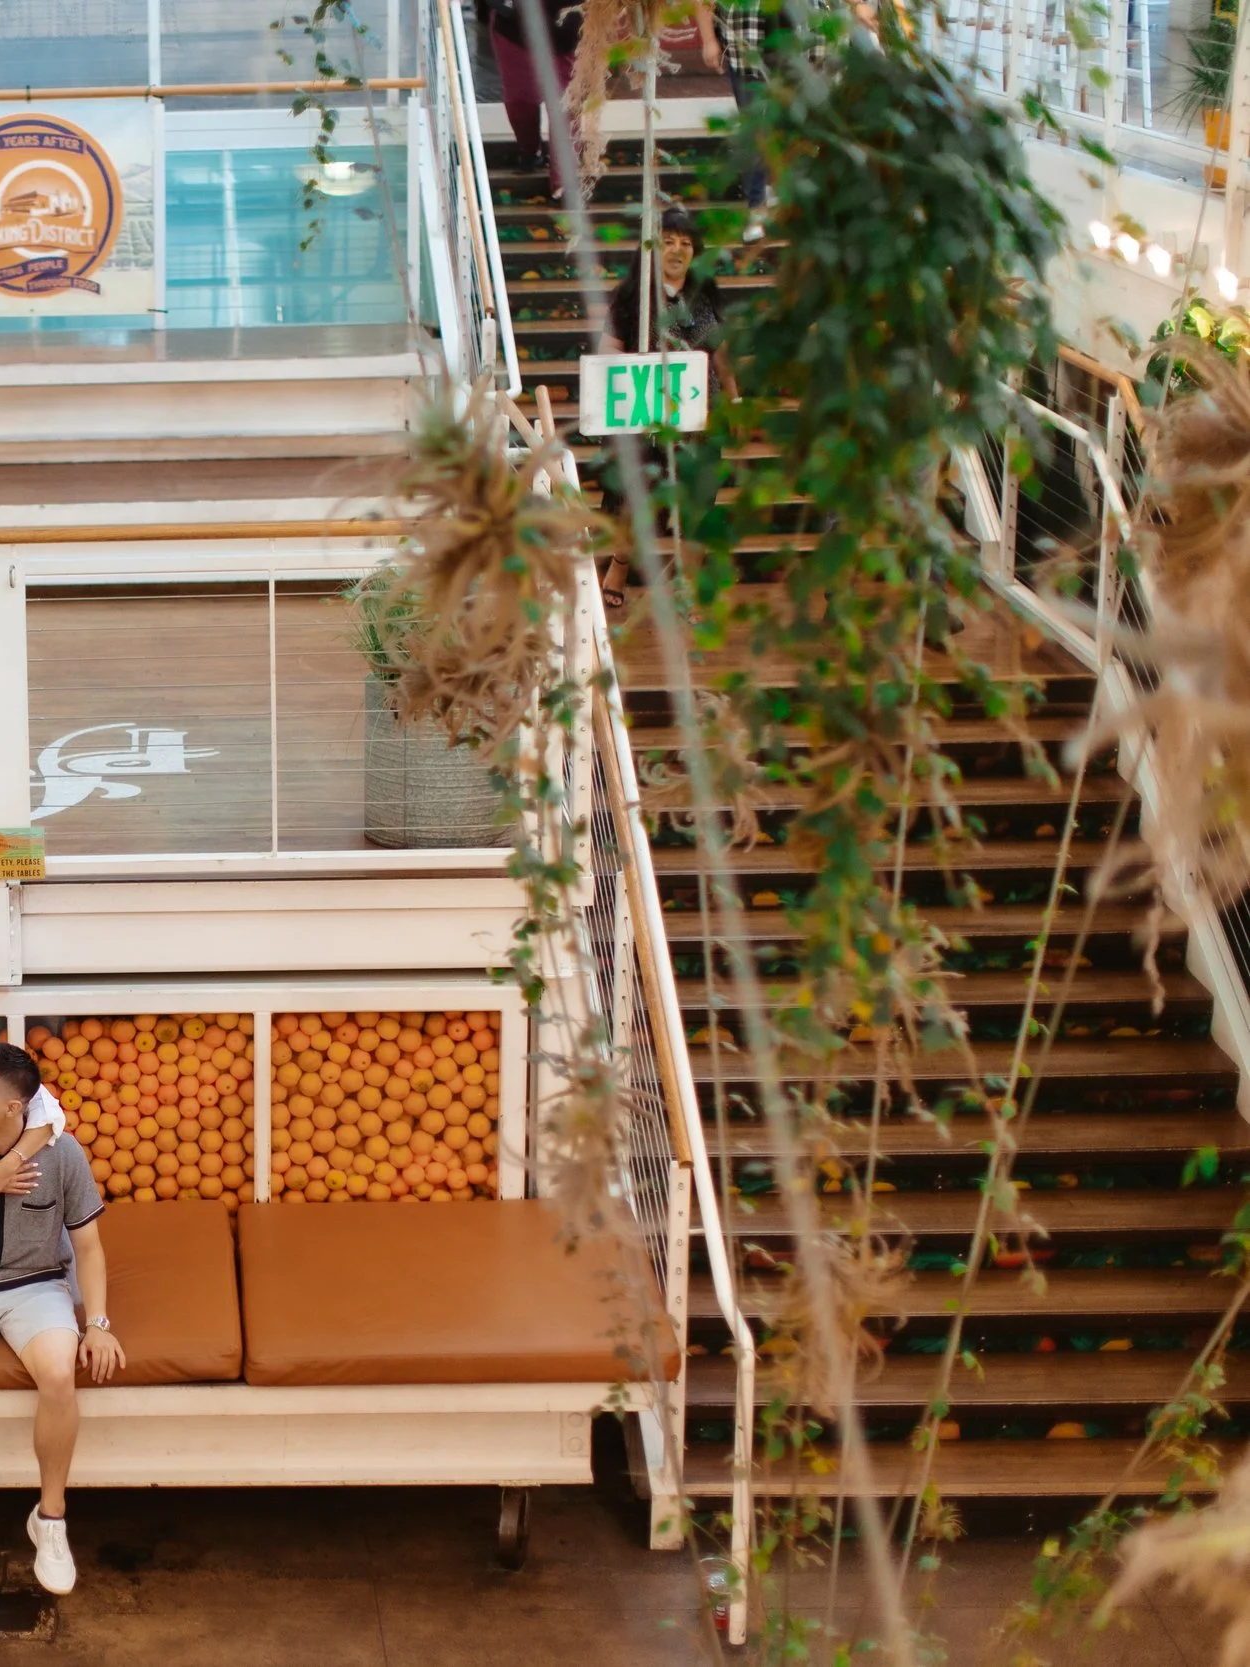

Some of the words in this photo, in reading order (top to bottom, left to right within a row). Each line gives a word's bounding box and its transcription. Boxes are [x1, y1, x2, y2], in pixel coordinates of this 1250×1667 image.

[2, 135, 40, 148] YEARS
[42, 135, 80, 151] AFTER
[26, 218, 95, 247] DISTRICT
[606, 362, 687, 427] EXIT
[16, 858, 41, 866] PLEASE
[16, 869, 41, 877] TABLES
